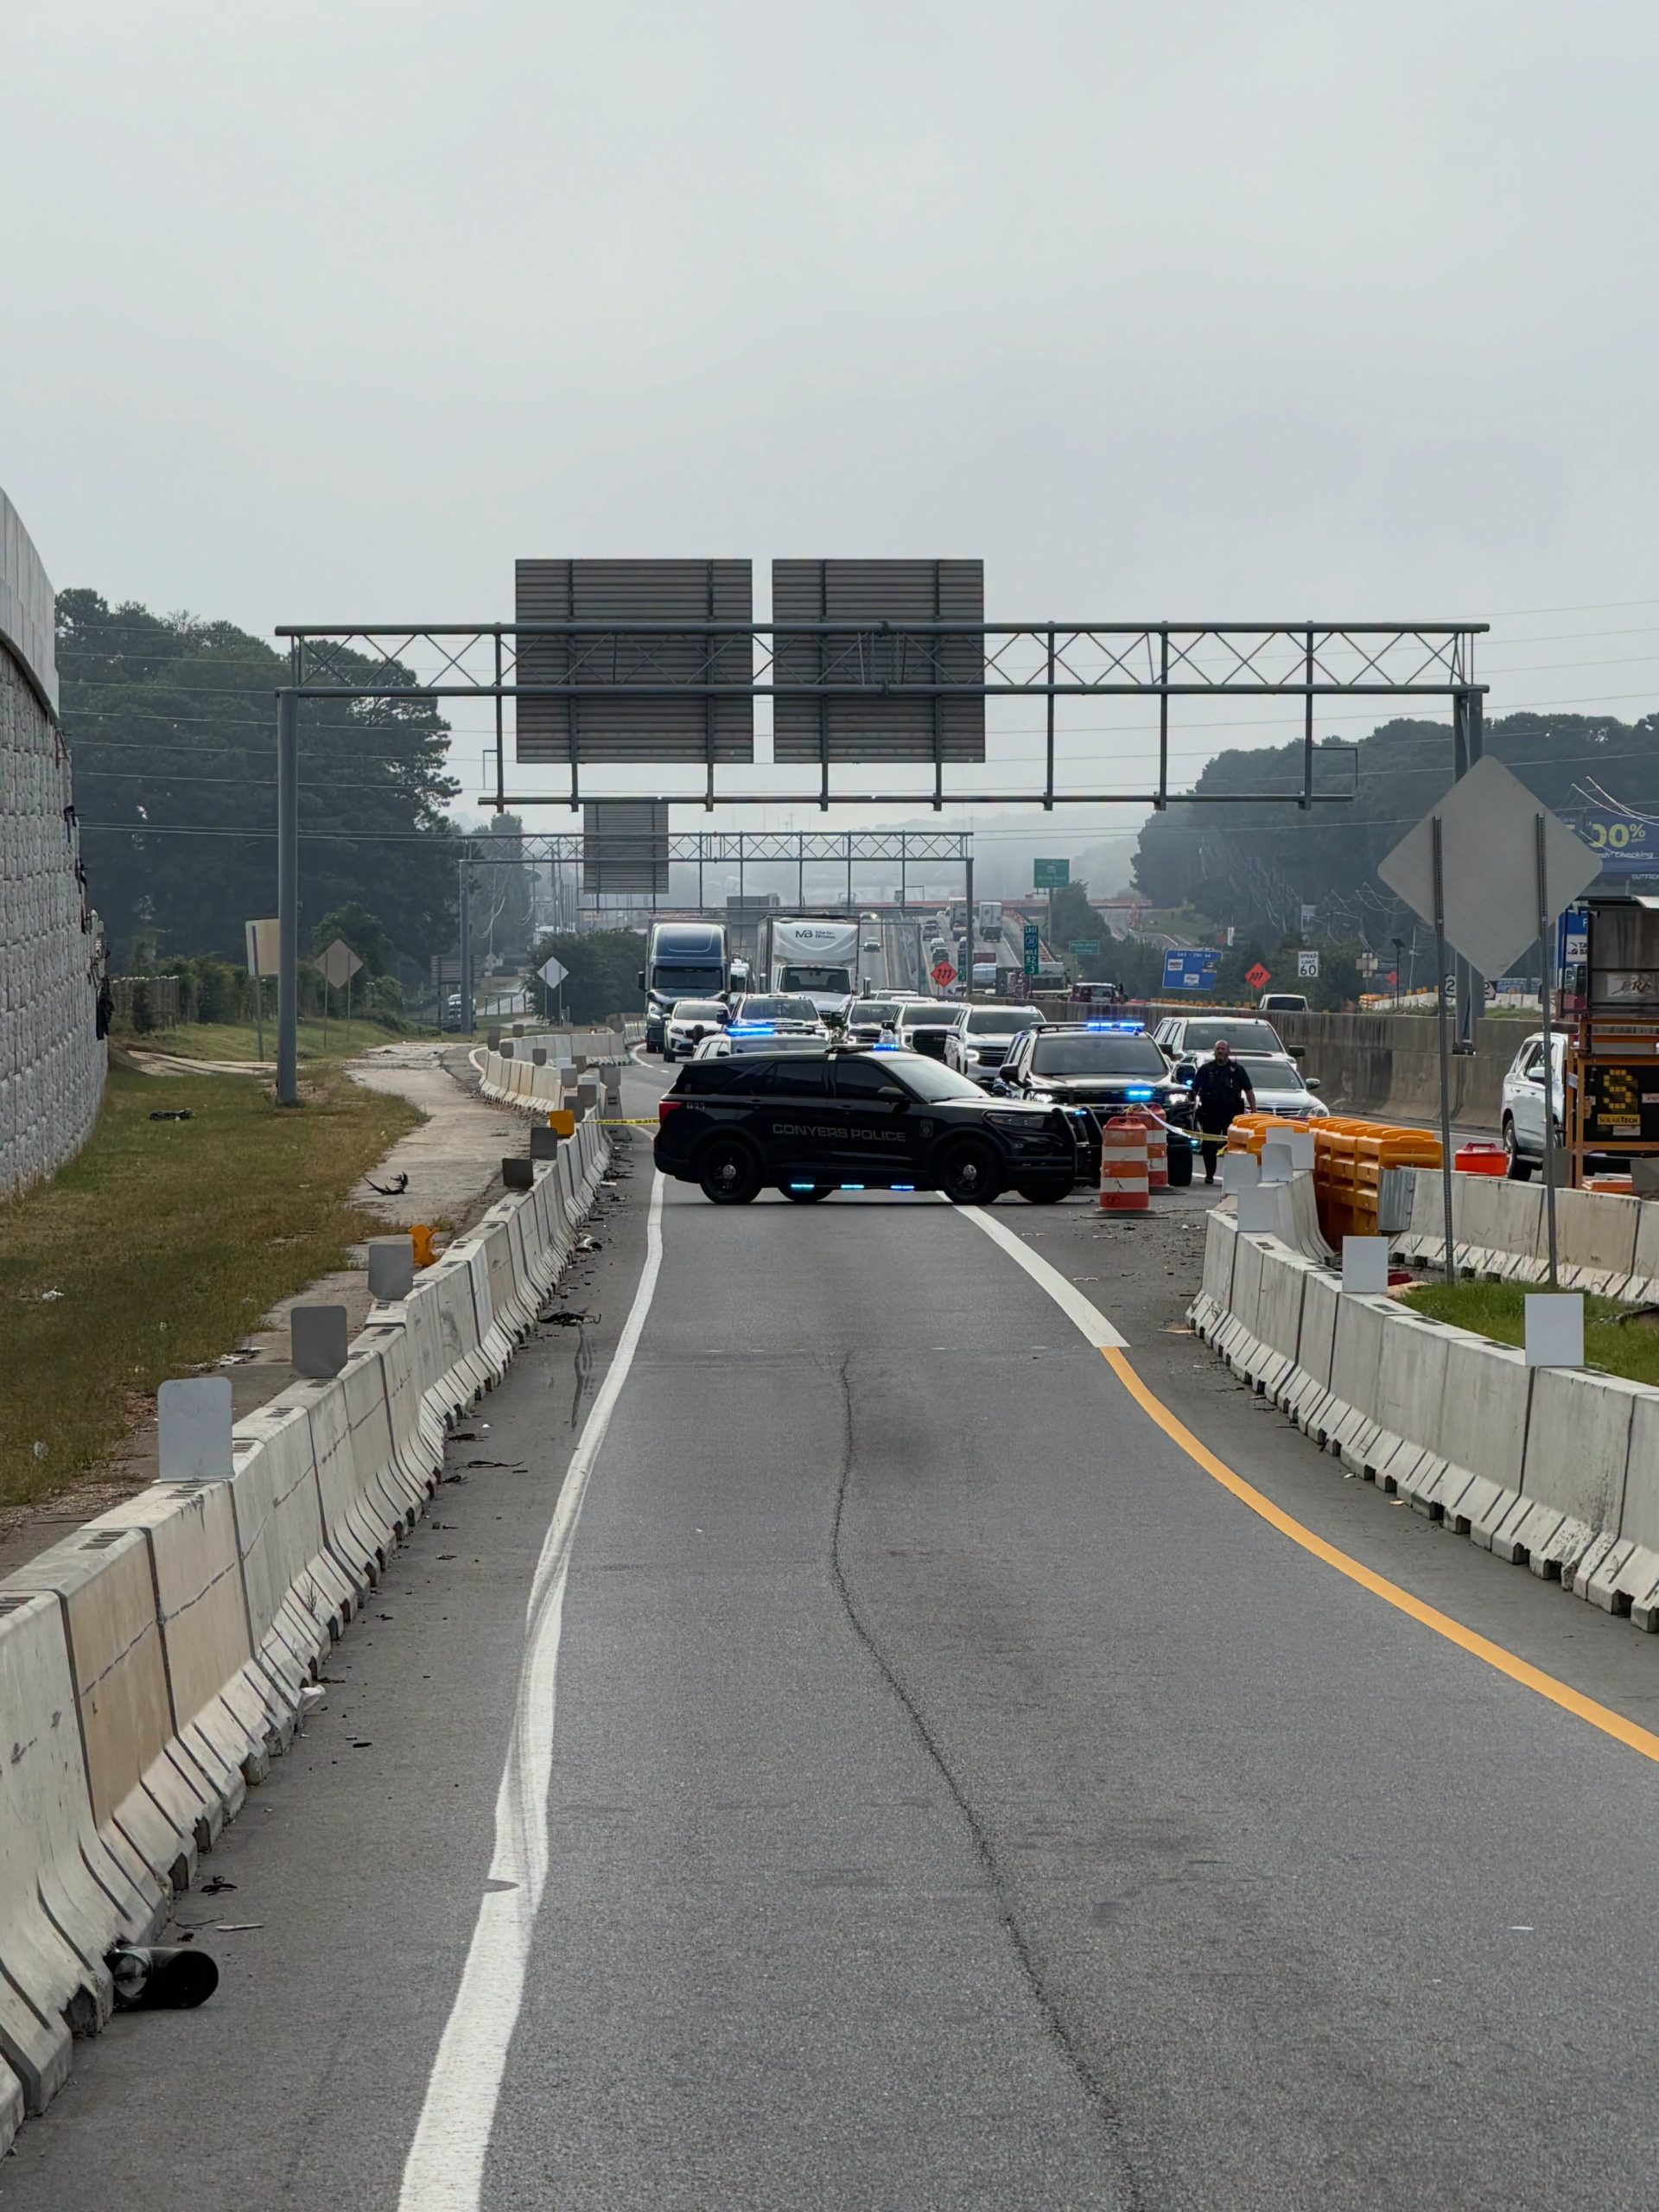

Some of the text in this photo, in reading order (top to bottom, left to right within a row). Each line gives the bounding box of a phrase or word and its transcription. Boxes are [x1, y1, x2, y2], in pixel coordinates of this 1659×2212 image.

[1300, 965, 1317, 976] 60
[772, 1123, 906, 1142] CONYERS POLICE
